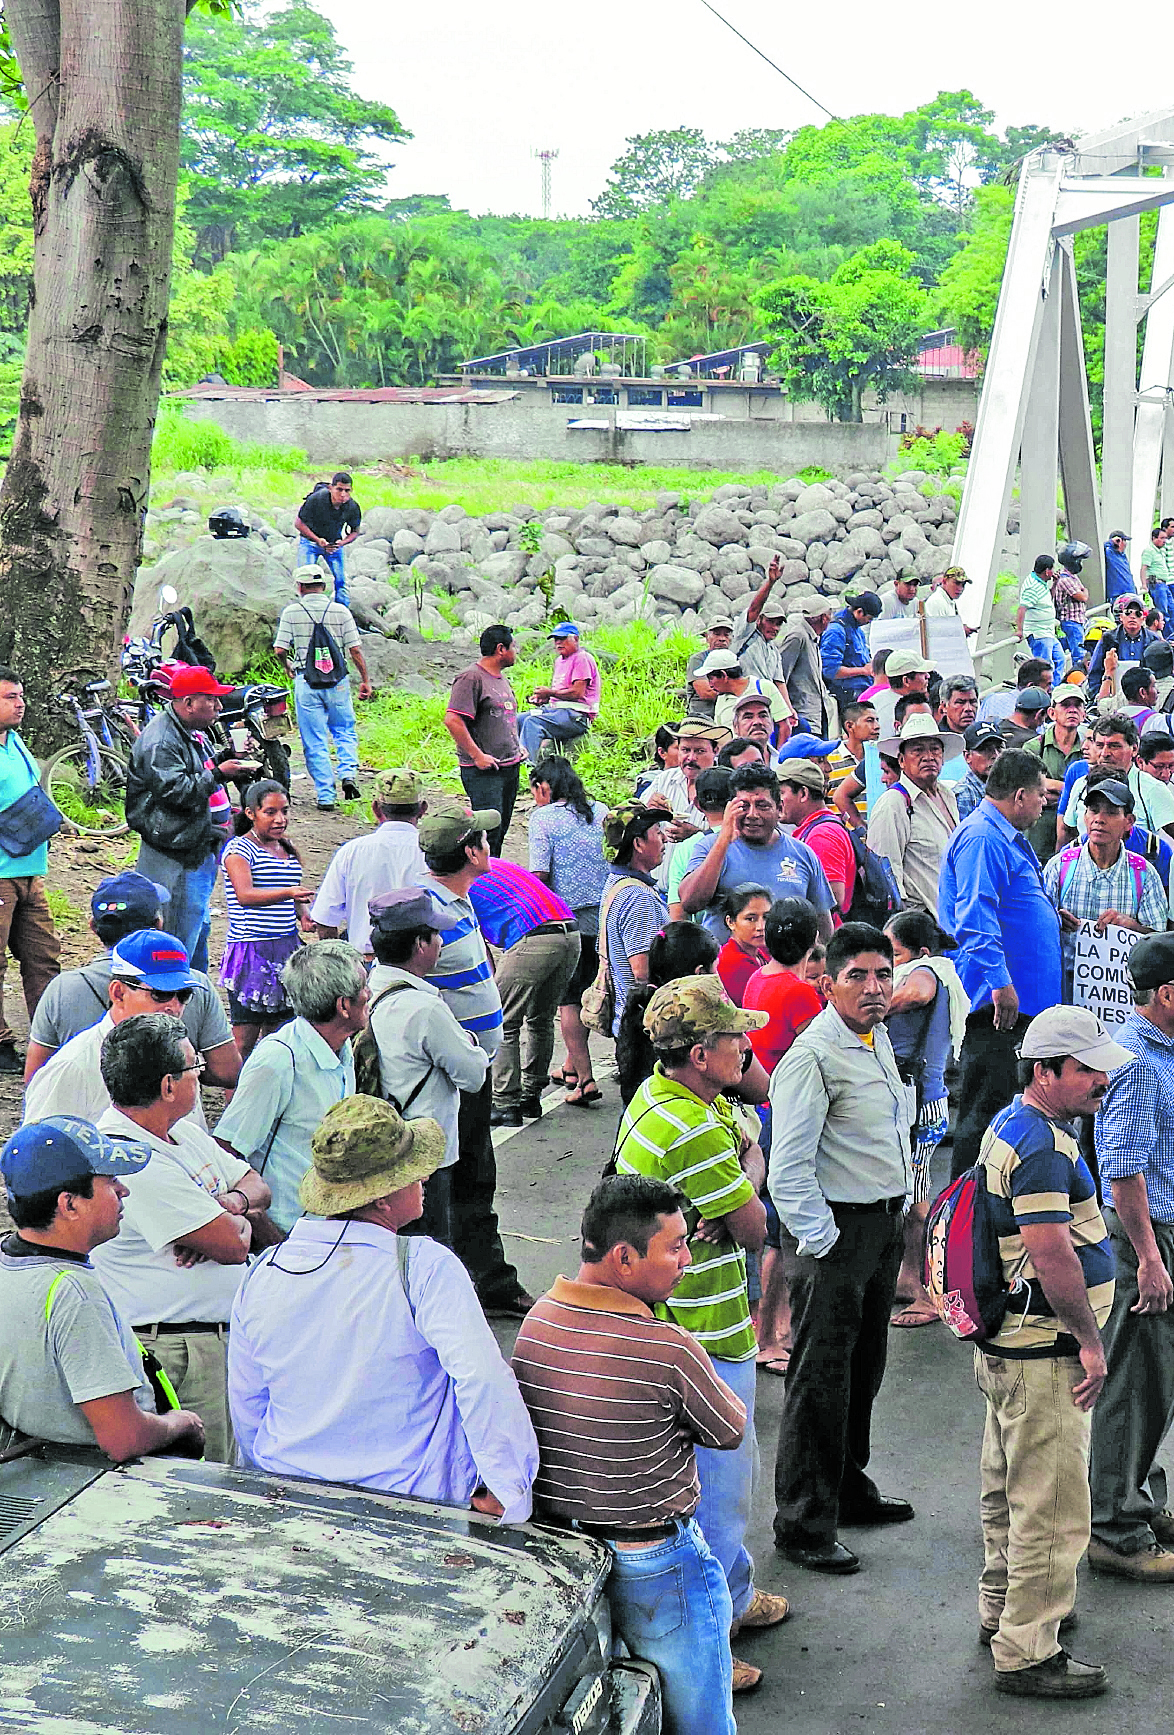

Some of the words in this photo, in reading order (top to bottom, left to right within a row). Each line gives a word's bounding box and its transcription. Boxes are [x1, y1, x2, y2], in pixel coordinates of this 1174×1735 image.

[1080, 922, 1108, 940] ASI
[1117, 930, 1138, 946] CO
[1077, 942, 1100, 959] LA
[1110, 948, 1129, 964] PA
[1077, 964, 1129, 985] COMU
[1077, 984, 1133, 1006] TAMBI
[62, 1118, 148, 1163] TEXAS
[572, 1676, 603, 1735] mazda
